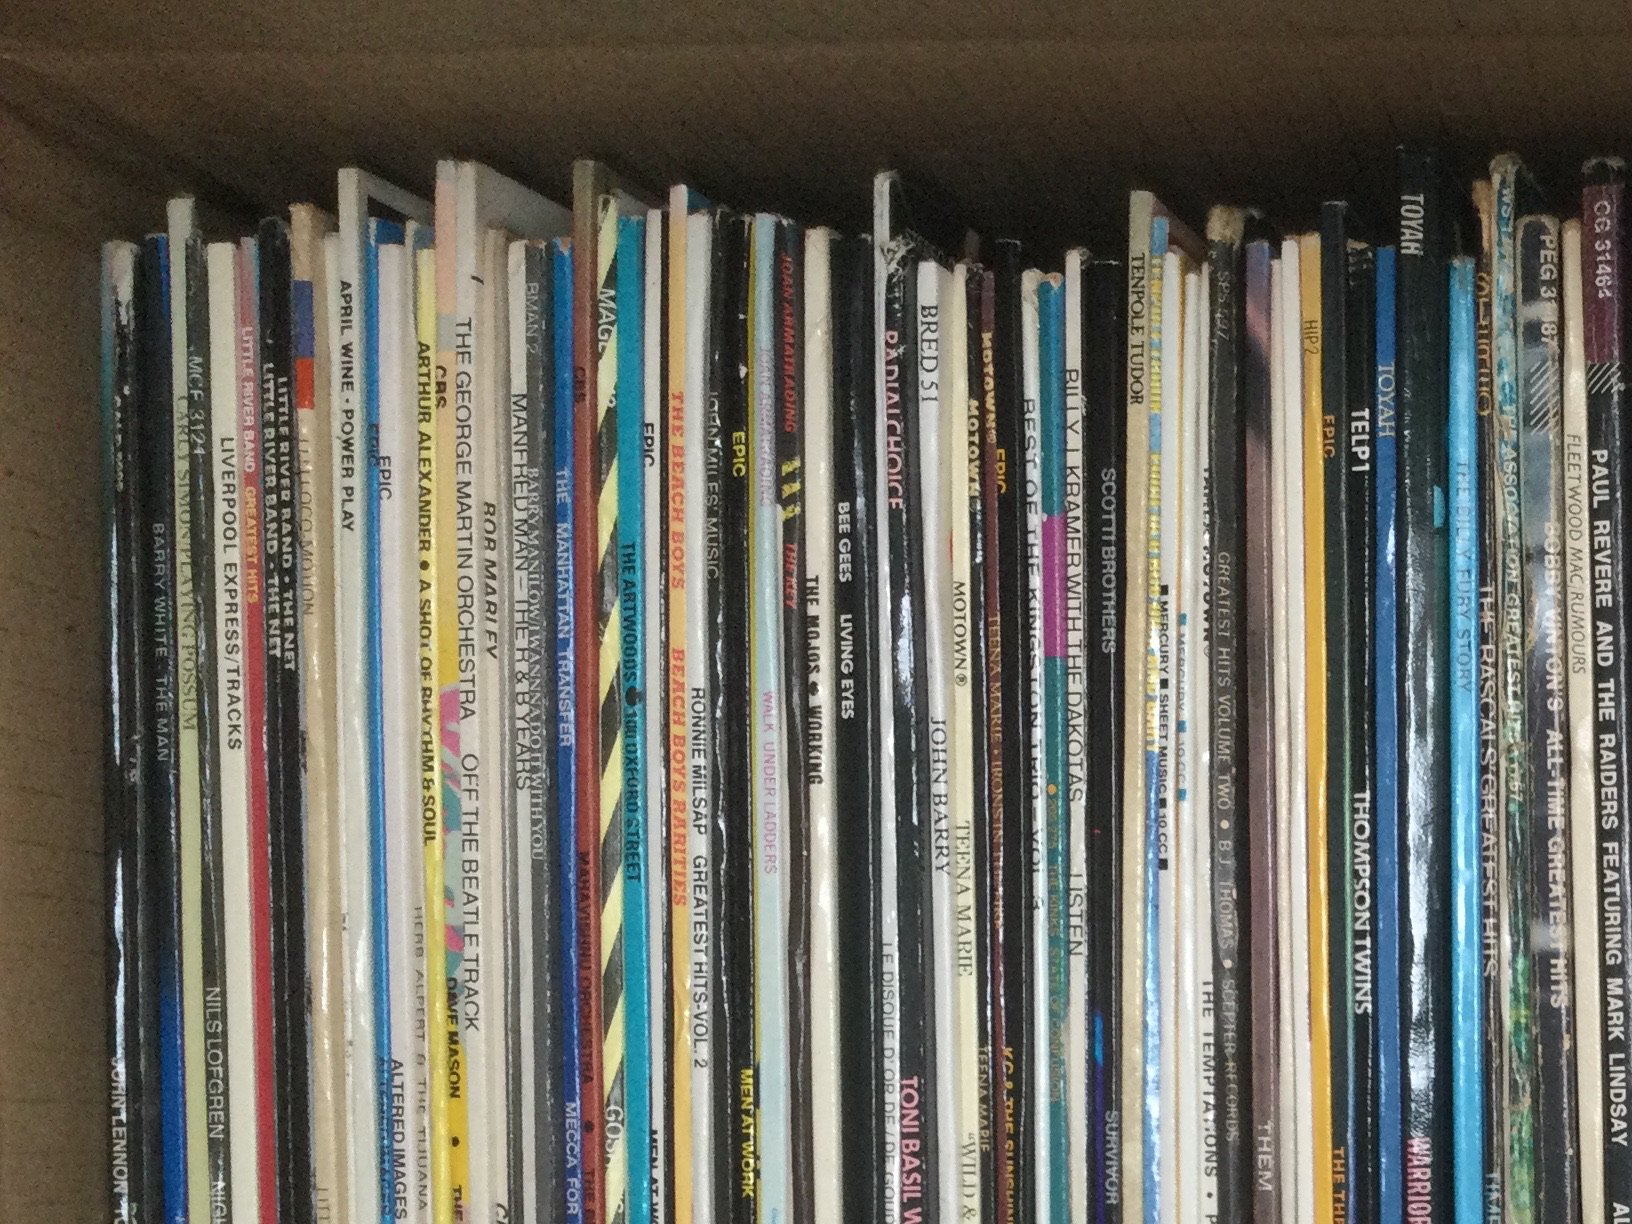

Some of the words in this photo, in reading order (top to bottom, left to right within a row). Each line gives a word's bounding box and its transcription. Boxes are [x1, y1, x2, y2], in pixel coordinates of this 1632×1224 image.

[1401, 194, 1424, 255] TOYAH
[341, 281, 354, 336] APRIL
[1130, 254, 1145, 335] TENPOLE
[242, 328, 253, 376] LITTLE
[341, 343, 355, 391] WINE
[456, 318, 472, 365] THE
[921, 305, 938, 371] BRED
[243, 382, 254, 424] RIVER
[1131, 343, 1145, 404] TUDOR
[1379, 364, 1395, 436] TOYAH
[244, 428, 255, 471] BAND
[341, 409, 356, 479] POWER
[456, 371, 473, 474] GEORGE
[220, 437, 237, 554] LIVERPOOL
[342, 486, 356, 532] PLAY
[556, 468, 571, 503] THE
[1567, 434, 1584, 540] FLEETWOOD
[1592, 449, 1610, 508] PAUL
[245, 487, 257, 563] GREATEST
[457, 481, 474, 570] MARTIN
[839, 502, 851, 533] BEE
[246, 569, 258, 602] HITS
[557, 523, 572, 637] MANHATTAN
[839, 538, 852, 582] GEES
[1594, 520, 1613, 609] REVERE
[840, 614, 853, 674] LIVING
[1569, 546, 1586, 673] MAC/RUMOURS
[1596, 621, 1614, 666] AND
[223, 563, 241, 750] EXPRESS/TRACKS
[458, 576, 475, 720] ORCHESTRA
[558, 650, 572, 746] TRANSFER
[692, 687, 707, 759] RONNIE
[841, 679, 854, 718] EYES
[1598, 679, 1616, 721] THE
[692, 764, 707, 835] MILSAP
[1599, 734, 1619, 829] RAIDERS
[1354, 792, 1371, 930] THOMPSON
[692, 856, 708, 957] GREATEST
[1602, 842, 1622, 965] FEATURING
[693, 963, 708, 1053] HITS-VOL.
[1355, 936, 1371, 1013] TWINS
[1605, 978, 1624, 1040] MARK
[693, 1059, 708, 1068] 2
[900, 1077, 921, 1133] TONI
[1607, 1053, 1627, 1146] LINDSAY
[901, 1139, 922, 1201] BASIL
[1258, 1121, 1273, 1190] THEM
